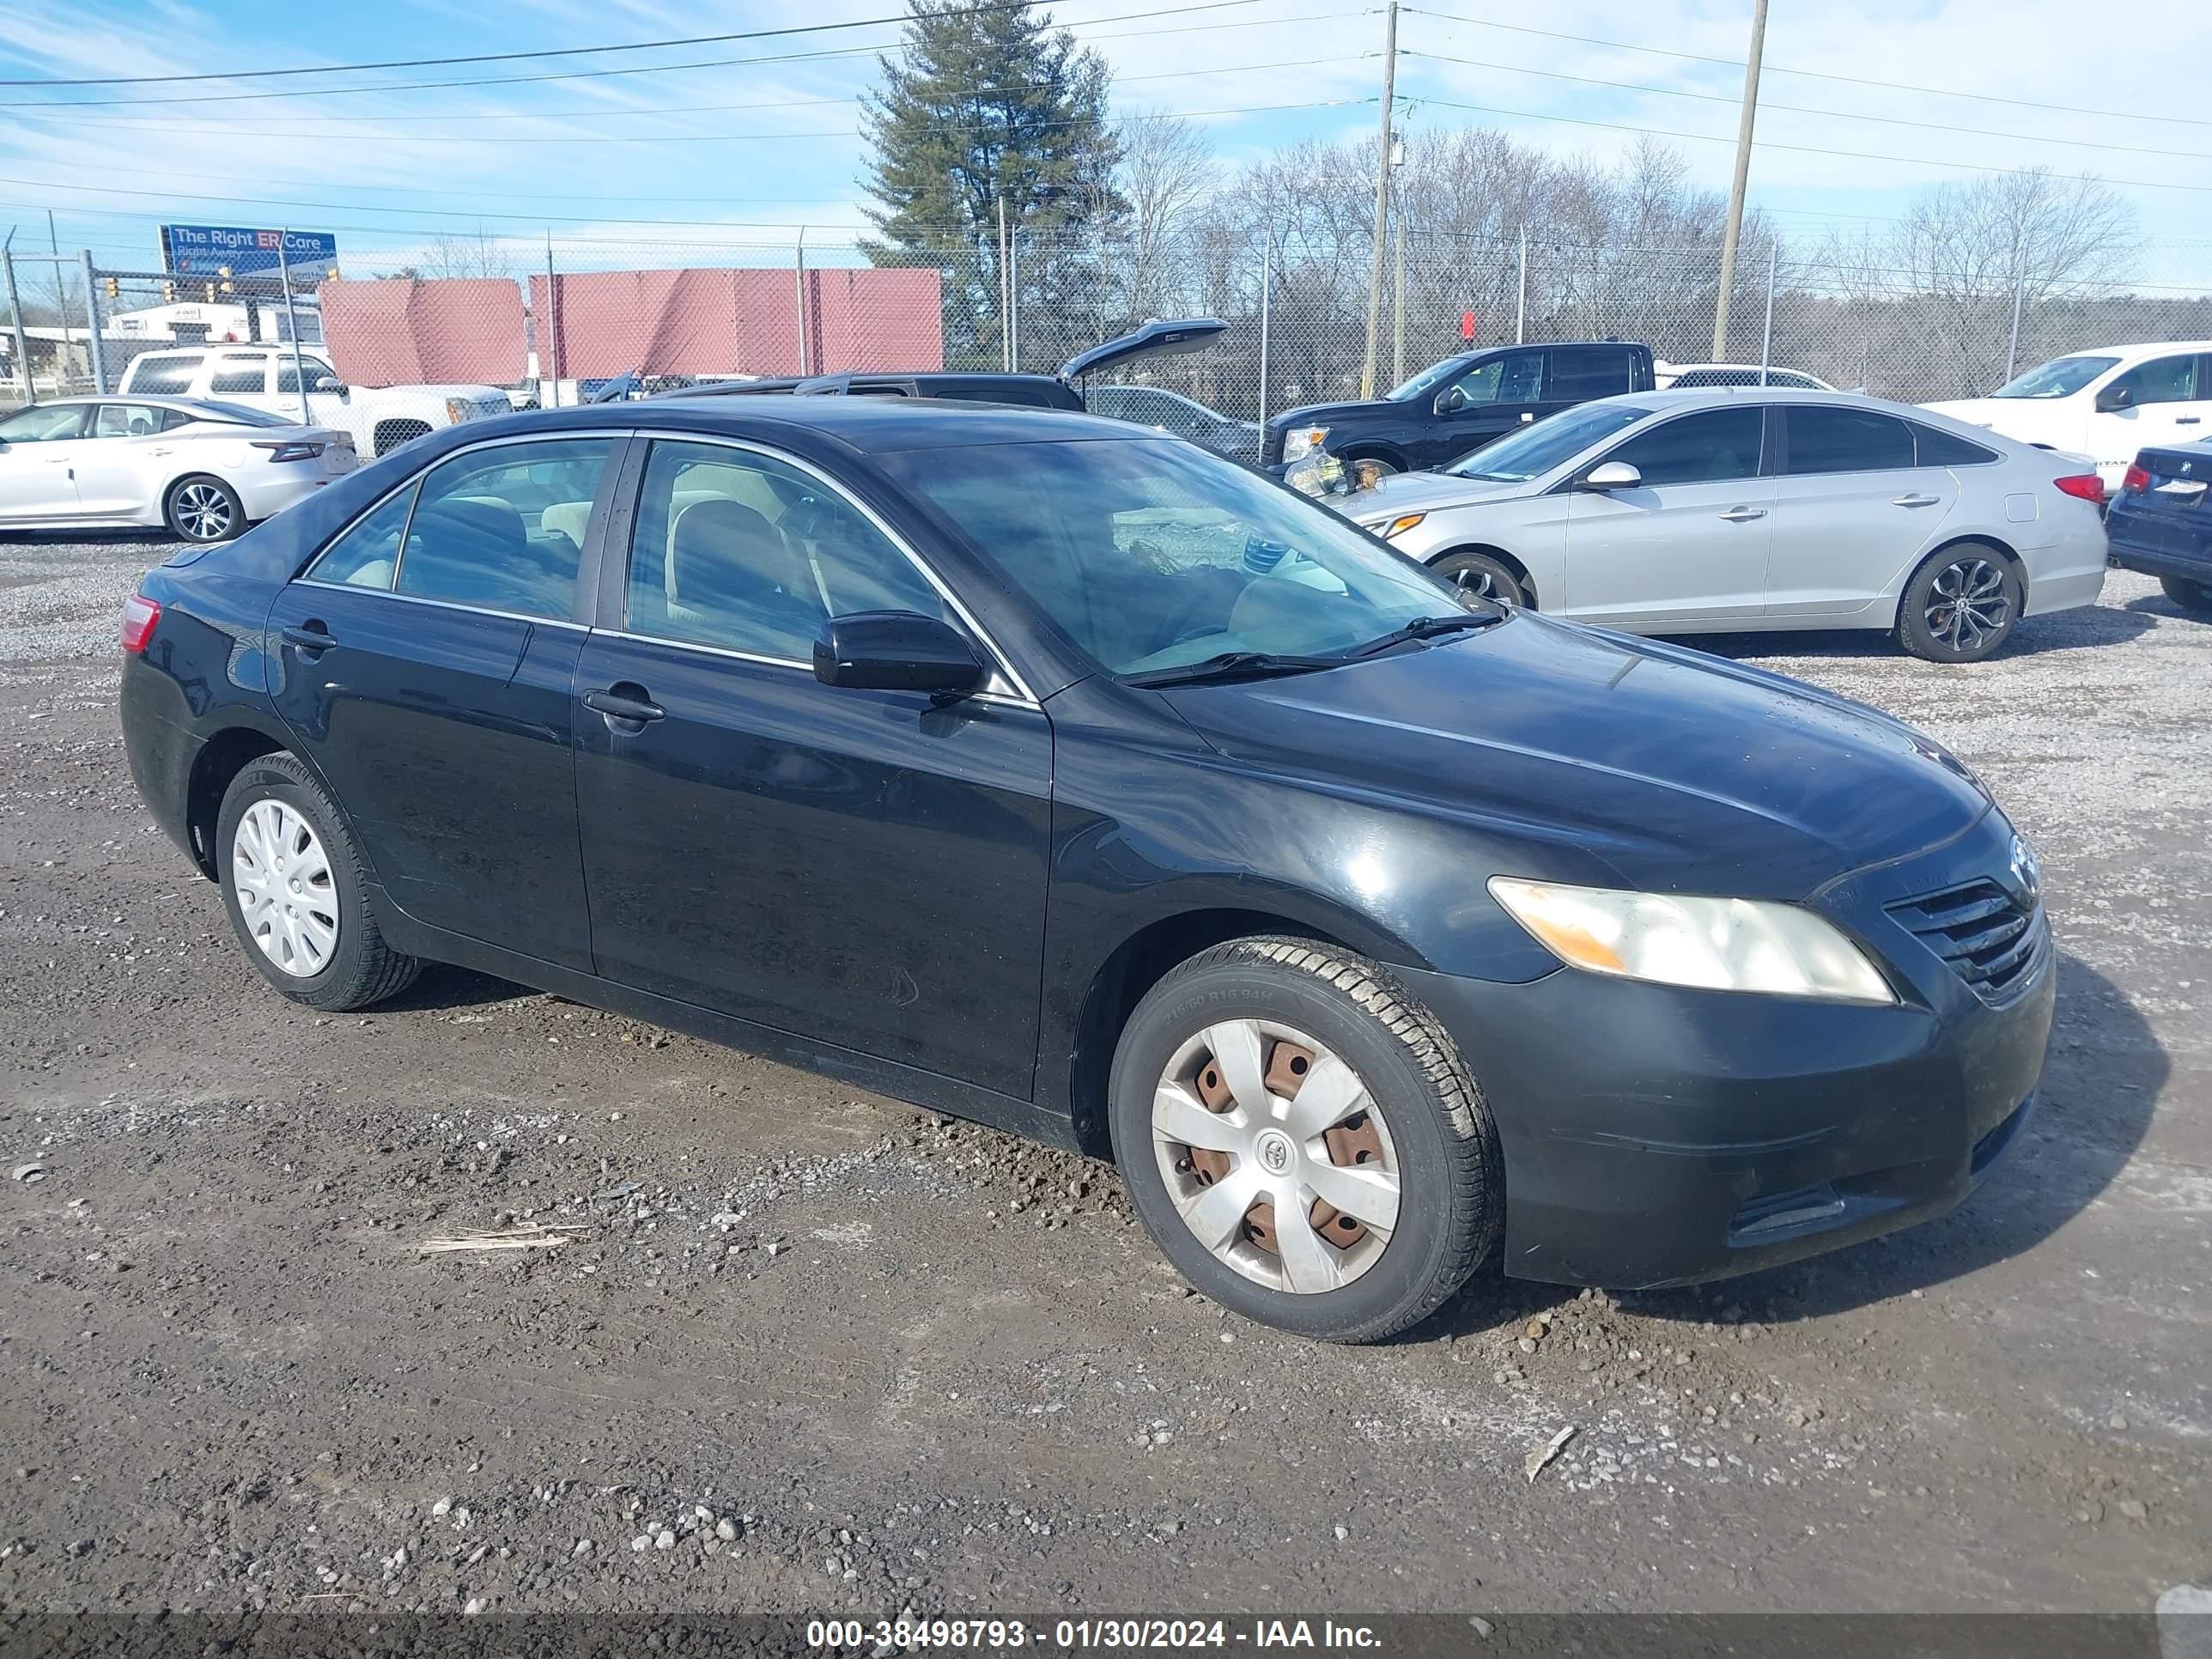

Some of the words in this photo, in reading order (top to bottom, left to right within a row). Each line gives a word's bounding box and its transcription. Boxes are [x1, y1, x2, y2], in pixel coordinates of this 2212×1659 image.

[175, 228, 207, 244] The
[211, 231, 253, 247] Right
[258, 233, 280, 246] ER
[286, 234, 320, 249] Care
[177, 246, 206, 258] Right
[1164, 995, 1205, 1025] 215/60
[1208, 989, 1237, 1002] R16
